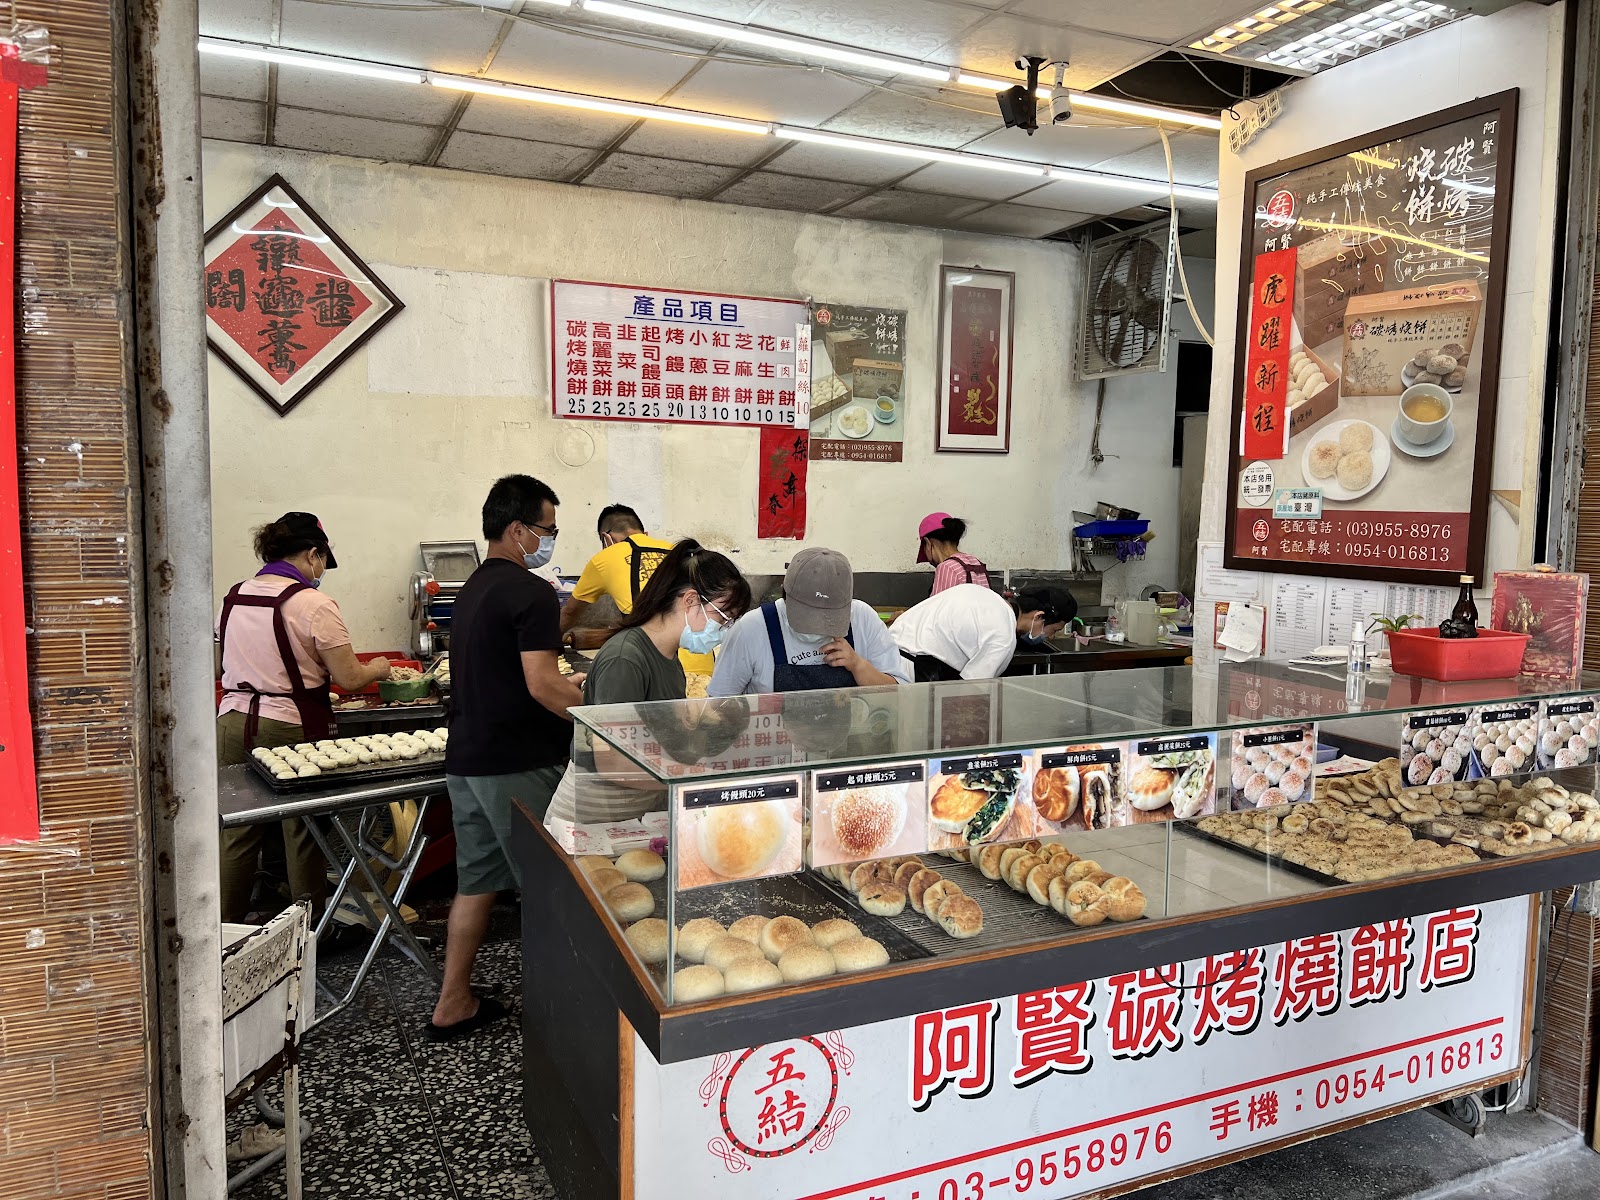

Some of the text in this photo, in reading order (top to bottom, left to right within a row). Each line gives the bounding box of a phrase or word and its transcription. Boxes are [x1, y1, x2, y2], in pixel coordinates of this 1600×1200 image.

[1482, 120, 1497, 155] 阿賢
[1264, 233, 1293, 252] 阿賢
[632, 295, 739, 322] 產品項目
[566, 319, 588, 415] 碳烤燒餅 25
[592, 321, 612, 417] 高麗菜餅 25
[617, 324, 637, 417] 韭菜餅 25
[641, 325, 661, 418] 起司饅頭 25
[665, 328, 685, 418] 烤饅頭 20
[688, 330, 708, 420] 小蔥餅 13
[712, 331, 731, 421] 紅豆餅 10
[734, 333, 754, 421] 芝麻餅 10
[757, 335, 775, 422] 花生餅 10
[778, 338, 796, 423] 鮮肉餅 15
[796, 401, 810, 415] 10
[1279, 540, 1450, 562] 宅配專線：0954-016813
[790, 651, 811, 665] Cute
[720, 787, 766, 801] 烤饅頭20元
[846, 771, 897, 785] 起司饅頭25元
[911, 907, 1482, 1110] 阿賢碳烤燒餅店
[754, 1047, 806, 1145] 五結
